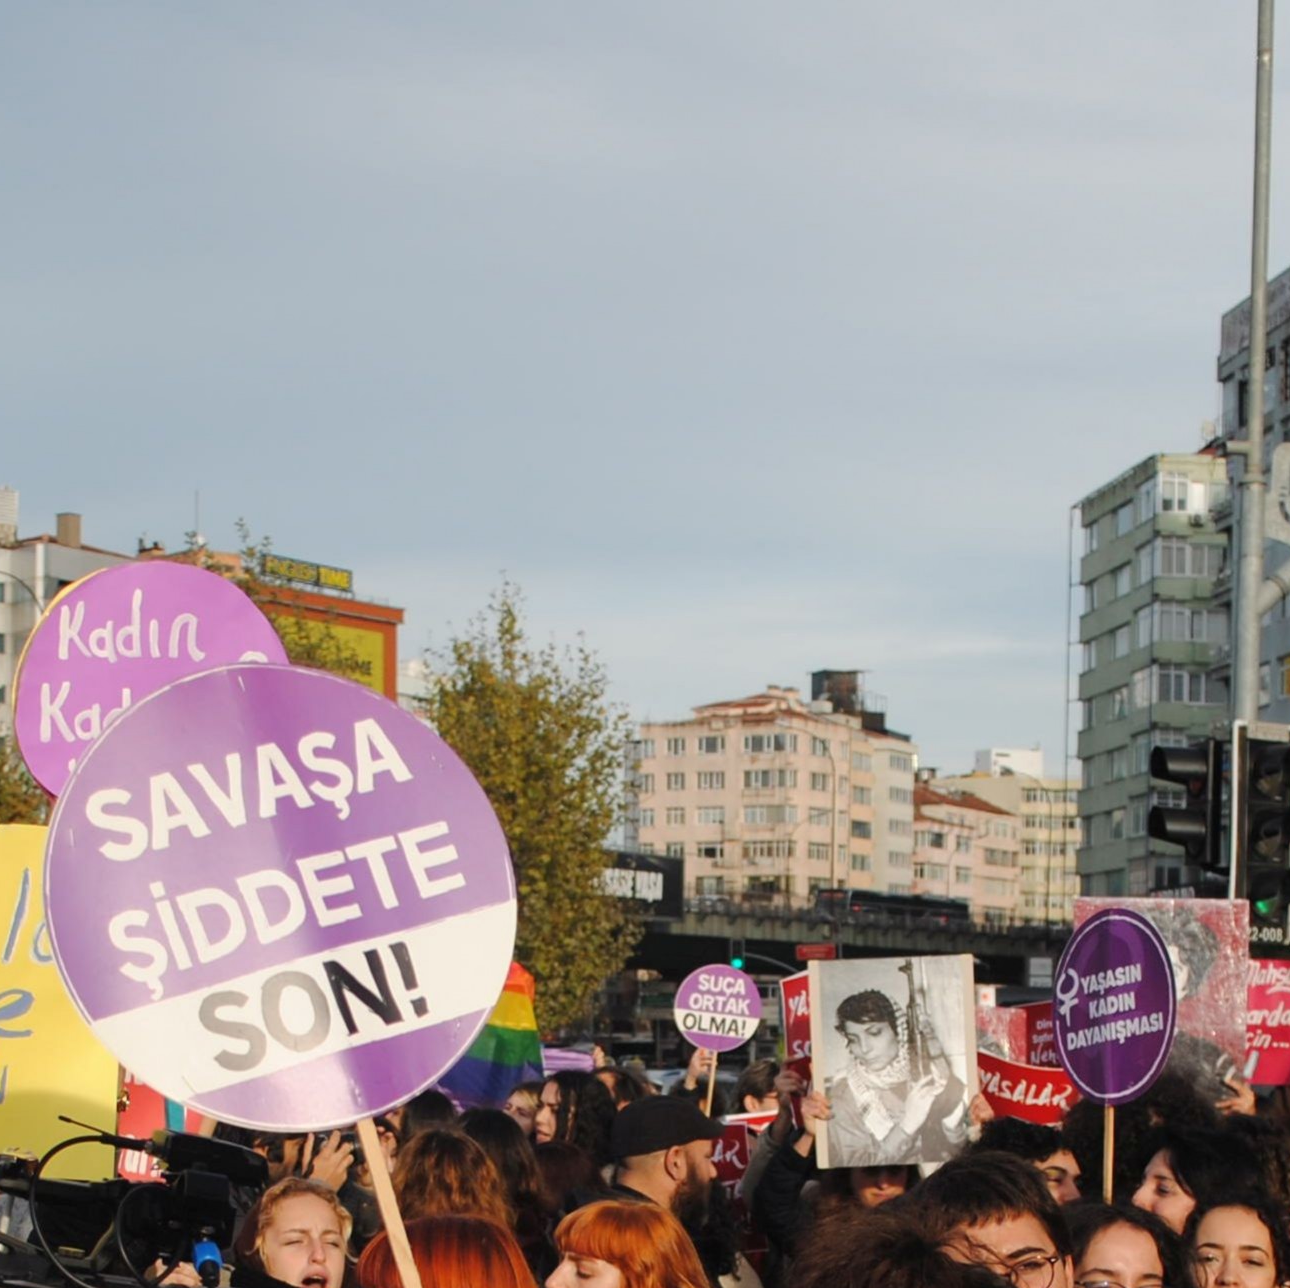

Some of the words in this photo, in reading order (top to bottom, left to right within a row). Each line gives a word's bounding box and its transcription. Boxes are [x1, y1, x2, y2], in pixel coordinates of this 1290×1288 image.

[58, 588, 205, 663] Kadın
[86, 718, 413, 861] SAVAŞA
[109, 821, 466, 1000] ŞİDDETE
[698, 974, 745, 996] SUÇA
[1080, 963, 1142, 995] YAŞASIN
[198, 940, 430, 1072] SON!
[689, 992, 751, 1015] ORTAK
[1089, 992, 1136, 1019] KADIN
[683, 1013, 746, 1036] OLMA!
[1067, 1012, 1164, 1051] DAYANIŞMASI
